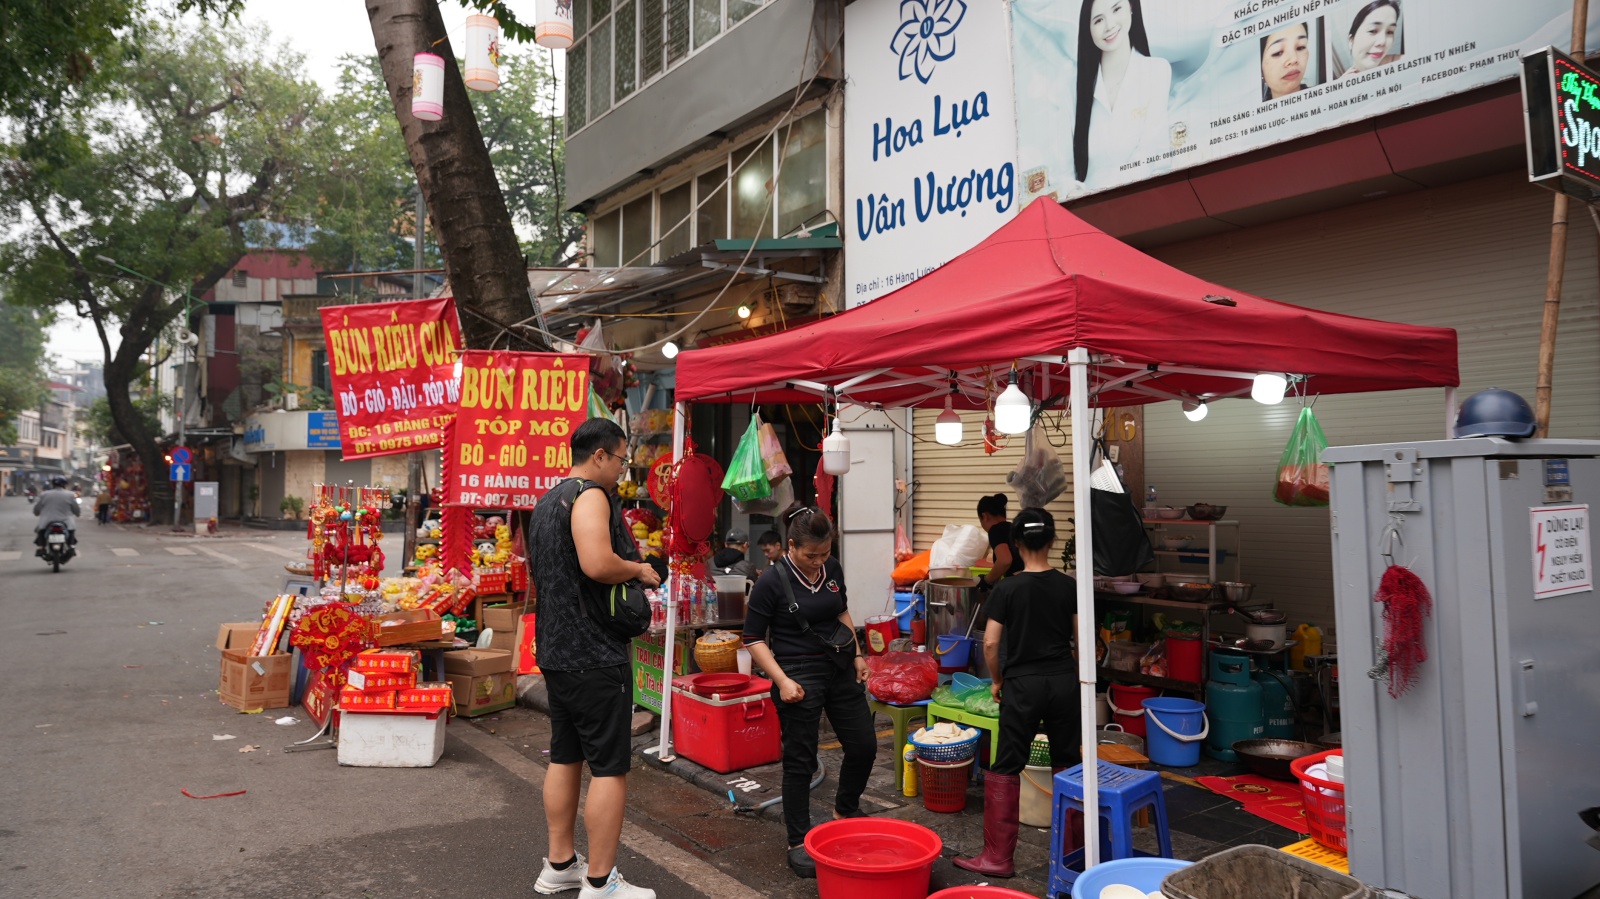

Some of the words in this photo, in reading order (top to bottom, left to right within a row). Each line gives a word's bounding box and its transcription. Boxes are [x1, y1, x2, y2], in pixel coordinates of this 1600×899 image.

[1222, 30, 1241, 44] ĐẶC
[1243, 24, 1256, 35] TRỊ
[1258, 19, 1271, 31] DA
[1273, 5, 1300, 25] NHIỀU
[1303, 0, 1321, 14] NẾP
[1234, 1, 1259, 19] KHẮC
[1210, 116, 1231, 129] TRẮNG
[1233, 110, 1250, 122] SÁNG
[1257, 102, 1278, 115] KHÍCH
[1280, 94, 1302, 107] THÍCH
[1325, 82, 1343, 94] SINH
[1345, 70, 1381, 88] COLAGEN
[1384, 65, 1395, 76] VÀ
[1397, 54, 1432, 72] ELASTIN
[1434, 49, 1446, 61] TỰ
[1449, 41, 1476, 57] NHIÊN
[933, 91, 990, 138] Lụa
[1209, 136, 1224, 146] ADD:
[1225, 132, 1239, 141] CS3:
[1240, 128, 1249, 137] 16
[1249, 123, 1267, 134] HÀNG
[1290, 111, 1309, 123] HÀNG
[1328, 99, 1348, 111] HOÀN
[1376, 87, 1387, 98] HÀ
[1388, 83, 1402, 94] NỘI
[1421, 65, 1467, 84] FACEBOOK:
[1469, 56, 1495, 70] PHẠM
[872, 117, 923, 161] Hoa
[1119, 160, 1141, 172] HOTLINE
[1146, 154, 1162, 164] ZALO:
[856, 193, 906, 241] Vân
[914, 162, 1014, 222] Vượng
[856, 283, 868, 295] Địa
[869, 277, 880, 291] chỉ
[886, 276, 894, 287] 16
[896, 271, 915, 284] Hàng
[329, 315, 373, 376] BÚN
[371, 310, 418, 372] RIÊU
[420, 319, 458, 367] CUA
[340, 384, 358, 416] BÒ
[365, 381, 386, 414] GIÒ
[391, 378, 417, 415] ĐẬU
[423, 374, 444, 407] TÓP
[460, 355, 516, 410] BÚN
[520, 357, 586, 412] RIÊU
[348, 425, 372, 439] ĐC:
[375, 424, 392, 435] 16
[394, 418, 430, 433] HÀNG
[474, 415, 522, 435] TÓP
[528, 416, 570, 437] MỠ
[355, 441, 376, 454] ĐT:
[380, 436, 412, 450] 0975
[414, 432, 438, 446] 049
[460, 438, 484, 466] BÒ
[499, 439, 527, 468] GIÒ
[544, 441, 573, 474] ĐẬ
[459, 474, 480, 487] 16
[484, 472, 529, 489] HÀNG
[460, 492, 482, 505] ĐT:
[484, 493, 508, 506] 097
[1547, 516, 1569, 533] DỪNG
[1551, 555, 1567, 567] NGUY
